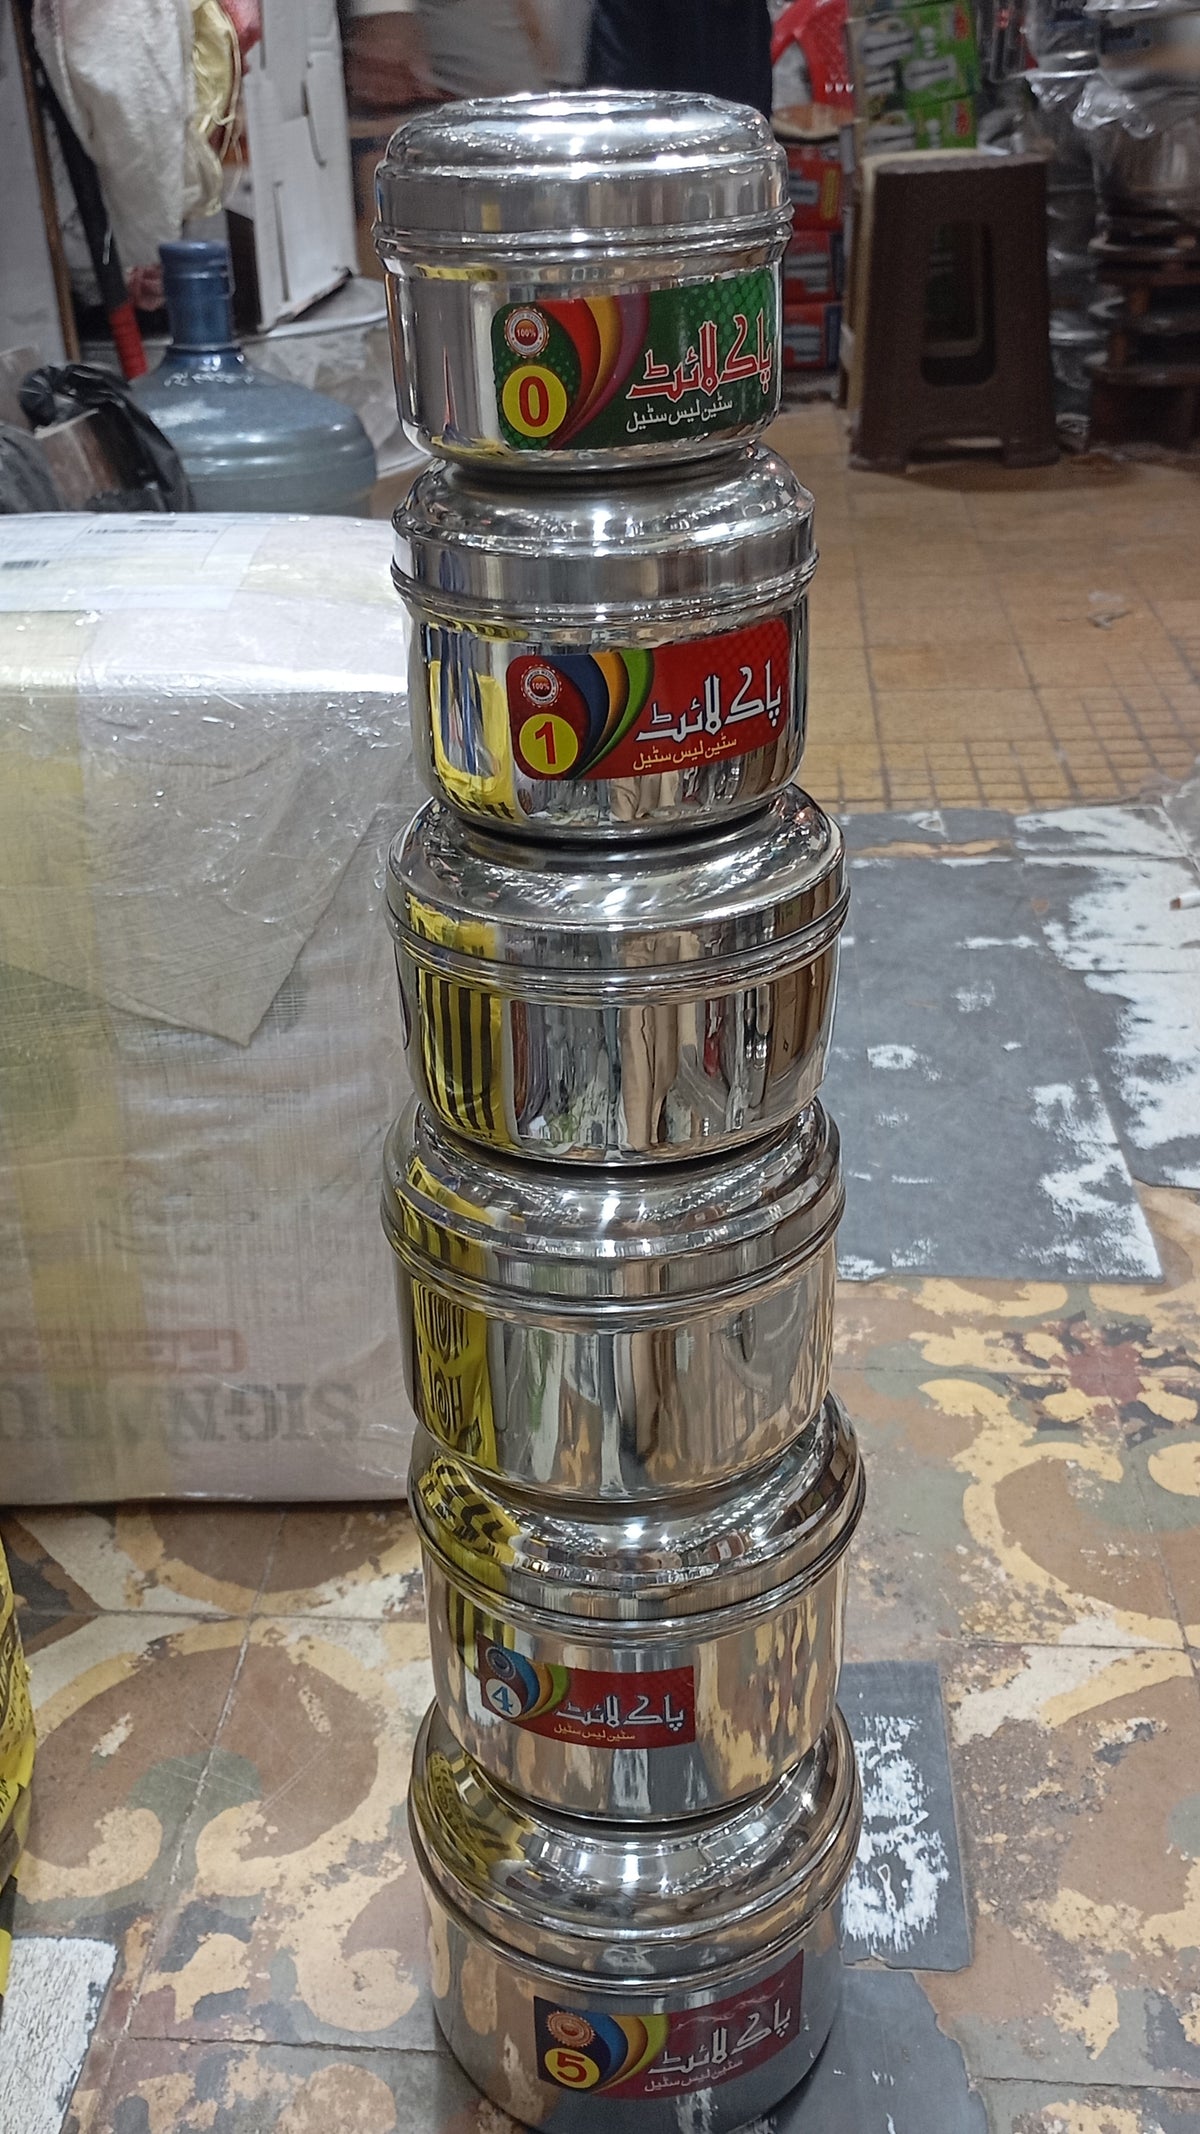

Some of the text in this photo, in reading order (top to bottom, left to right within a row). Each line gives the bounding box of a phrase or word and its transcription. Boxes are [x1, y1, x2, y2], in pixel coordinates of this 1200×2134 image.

[626, 320, 719, 402] لائٹ
[518, 375, 549, 427] 0
[635, 659, 782, 743] پاک لائٹ
[534, 721, 558, 765] 1
[491, 1685, 514, 1716] 4
[624, 1694, 685, 1732] پاک
[557, 2051, 588, 2083] 5
